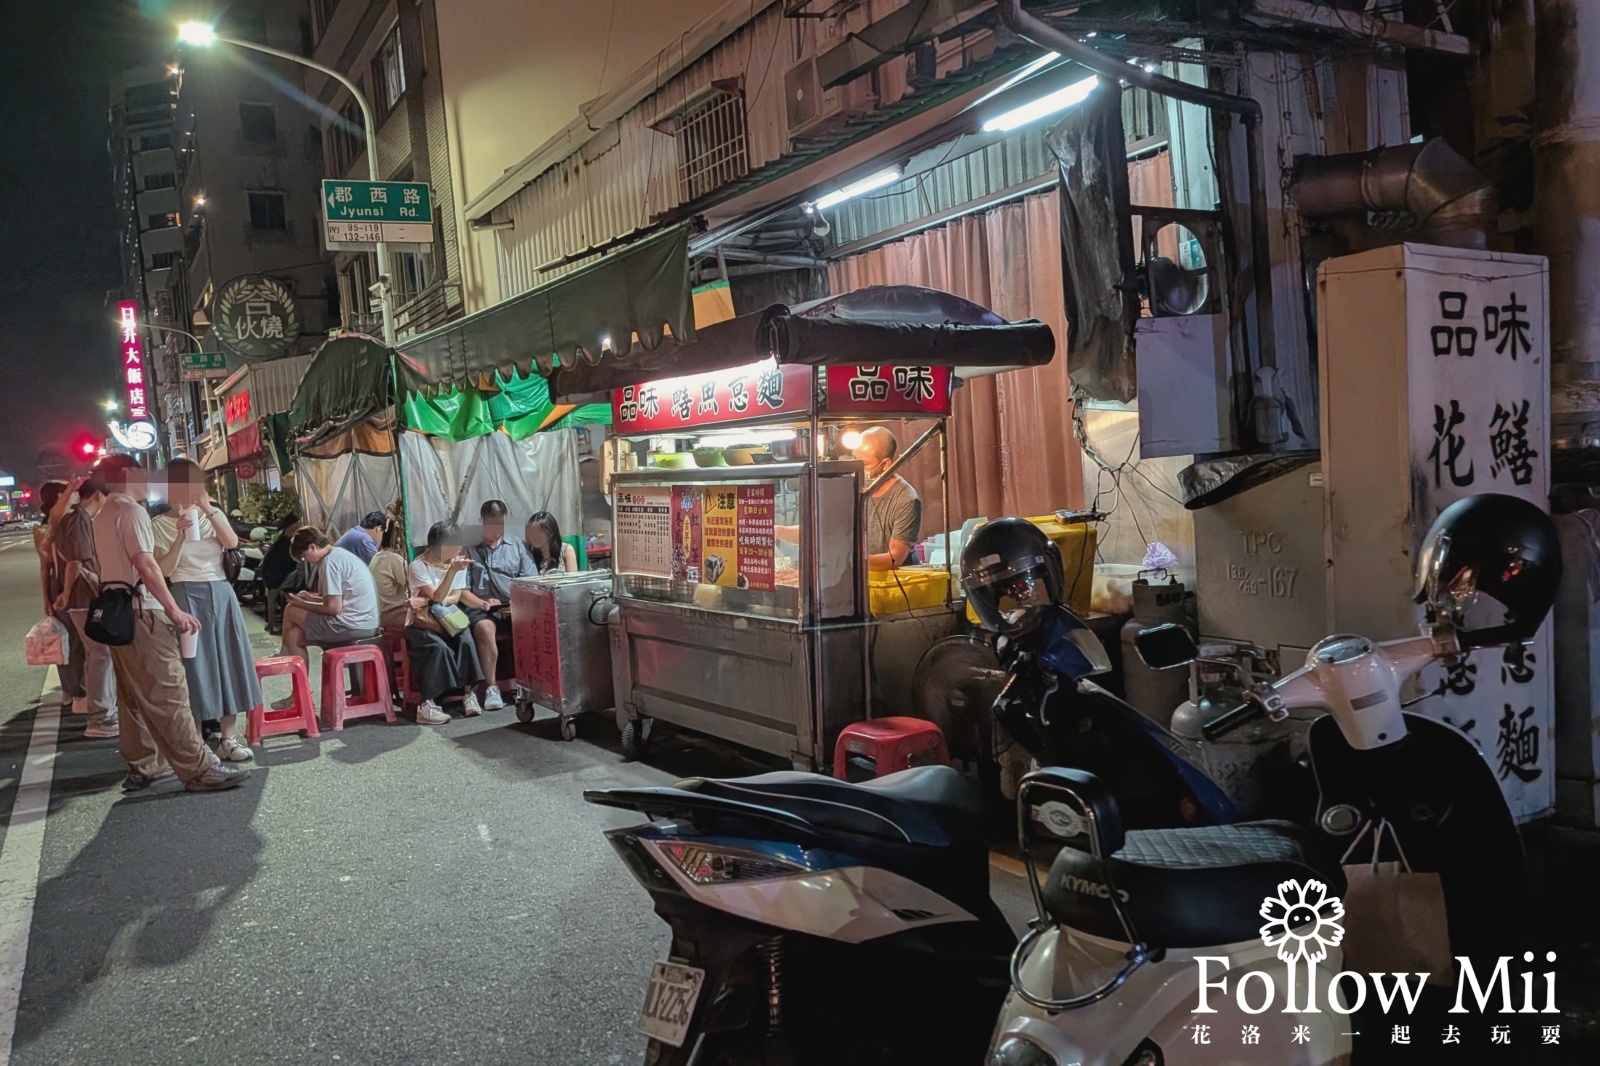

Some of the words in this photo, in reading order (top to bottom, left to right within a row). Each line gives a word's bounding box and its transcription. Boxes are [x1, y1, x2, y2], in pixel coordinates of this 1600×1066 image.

[334, 186, 421, 205] 郡西路
[340, 206, 384, 218] Jyunsi
[399, 207, 419, 217] Rd.
[344, 232, 380, 241] 132-146
[1430, 291, 1532, 361] 品味
[848, 366, 935, 403] 品味
[619, 385, 660, 422] 品味
[717, 492, 735, 510] 注意
